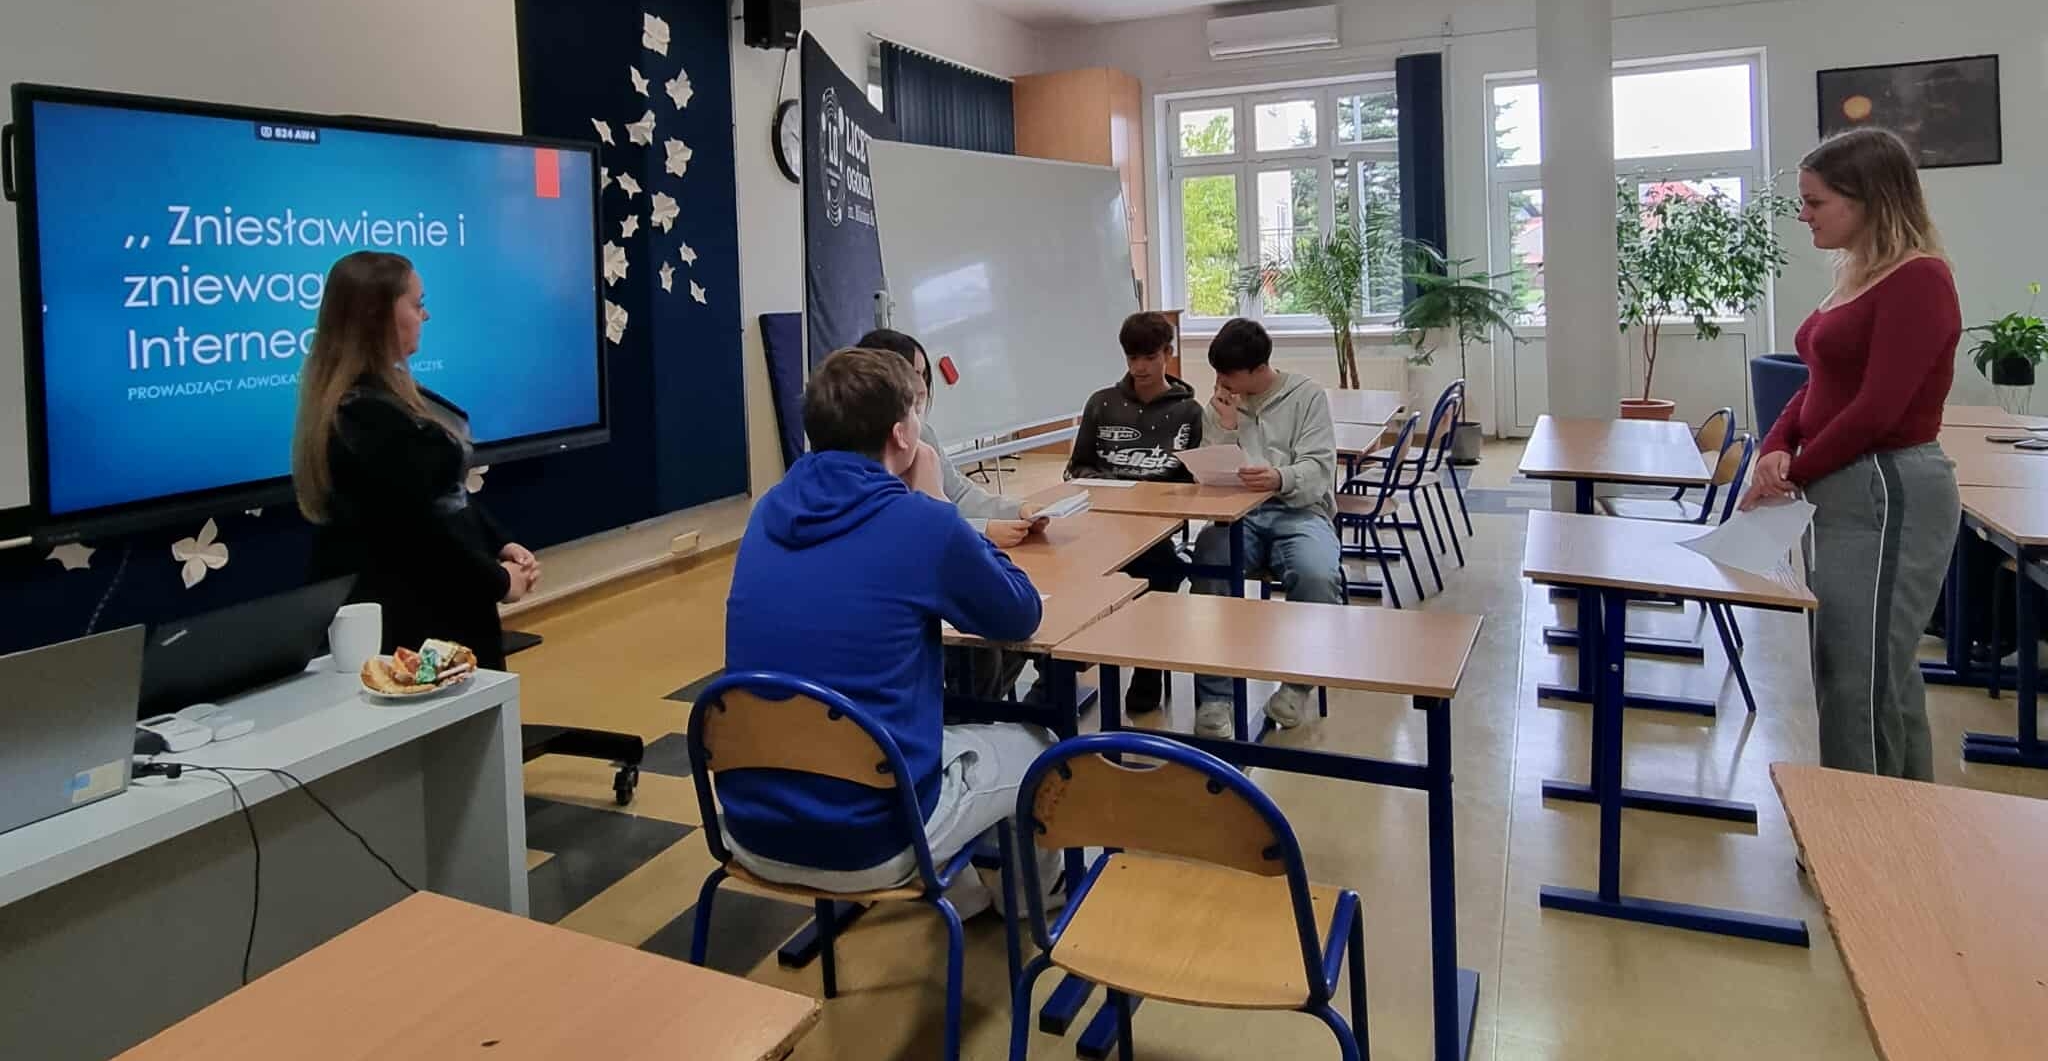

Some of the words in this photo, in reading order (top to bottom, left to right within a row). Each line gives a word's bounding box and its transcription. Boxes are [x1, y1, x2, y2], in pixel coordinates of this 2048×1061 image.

[846, 115, 872, 163] LICE
[167, 205, 449, 247] Zniesławienie
[458, 213, 466, 247] i
[127, 378, 233, 400] PROWADZĄCY
